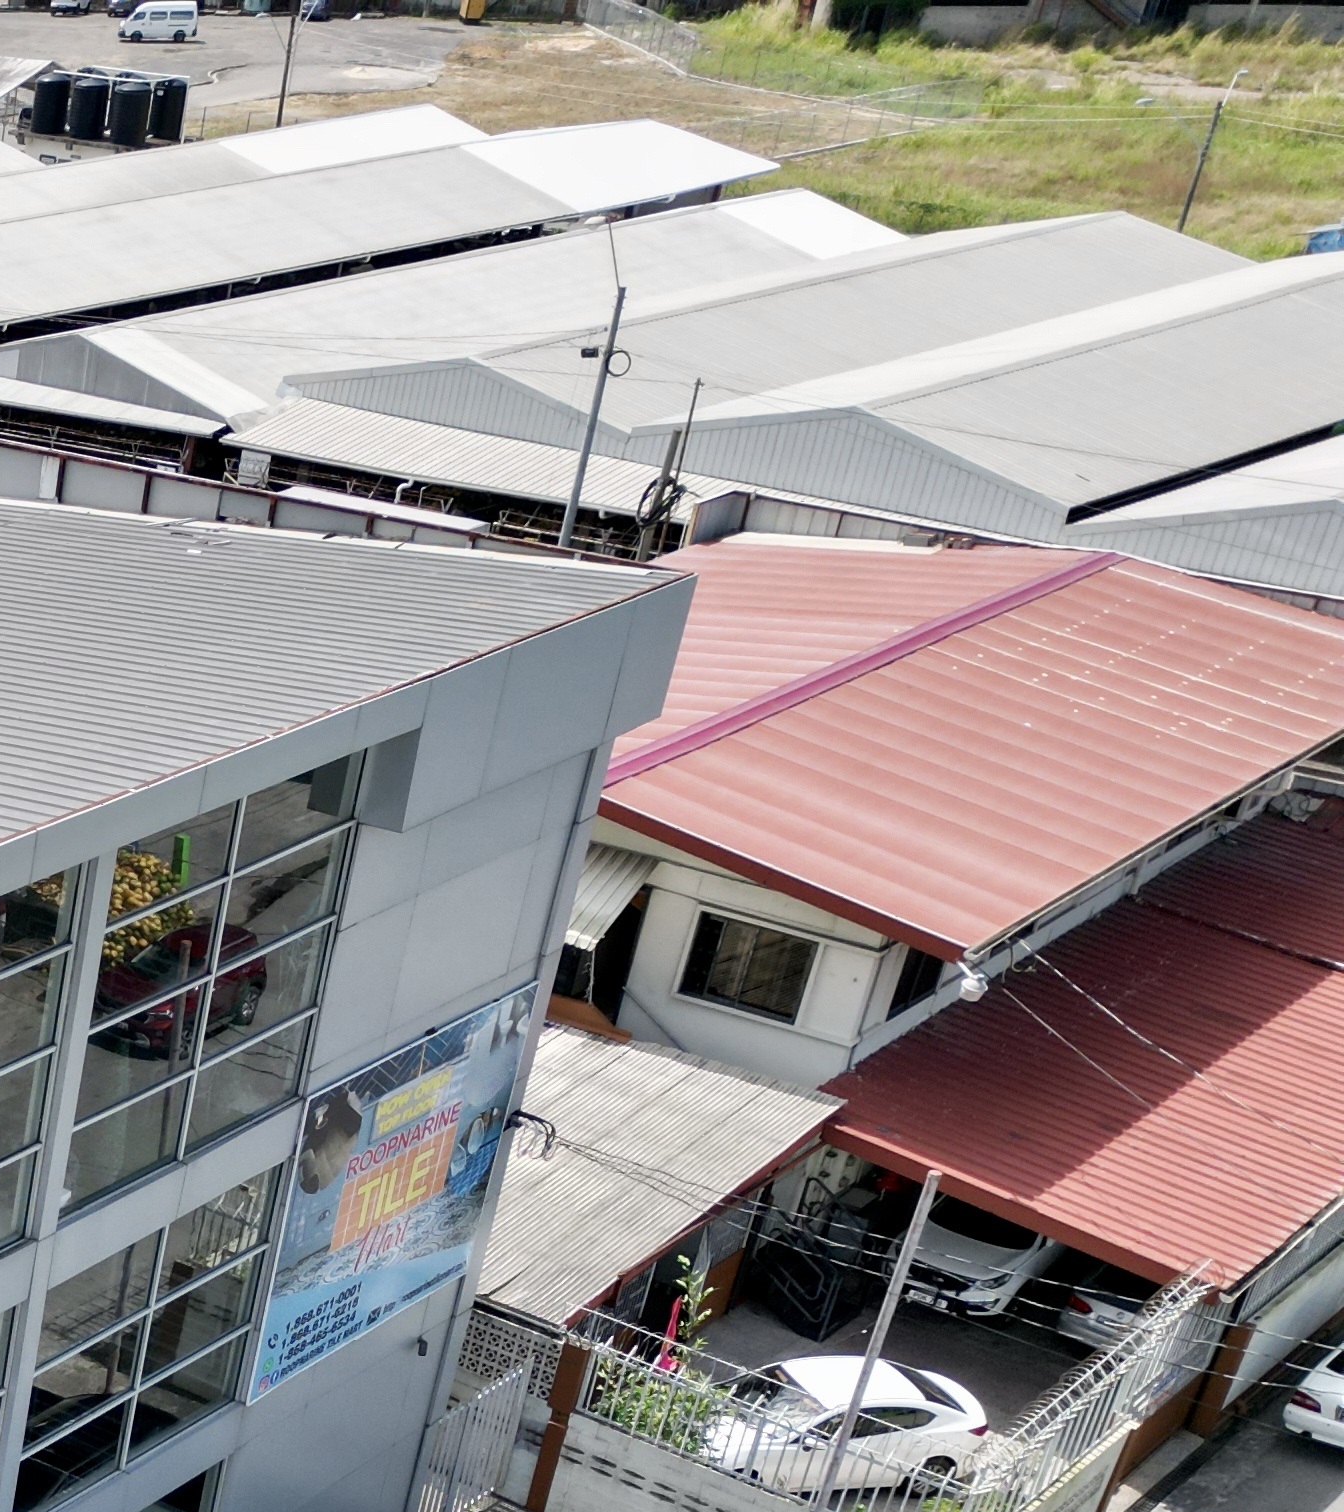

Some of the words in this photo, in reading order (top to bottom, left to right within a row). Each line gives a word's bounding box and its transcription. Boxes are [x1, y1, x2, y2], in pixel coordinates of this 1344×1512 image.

[345, 1100, 462, 1180] ROOPNARINE
[357, 1147, 435, 1230] TILE
[354, 1214, 411, 1273] Mart
